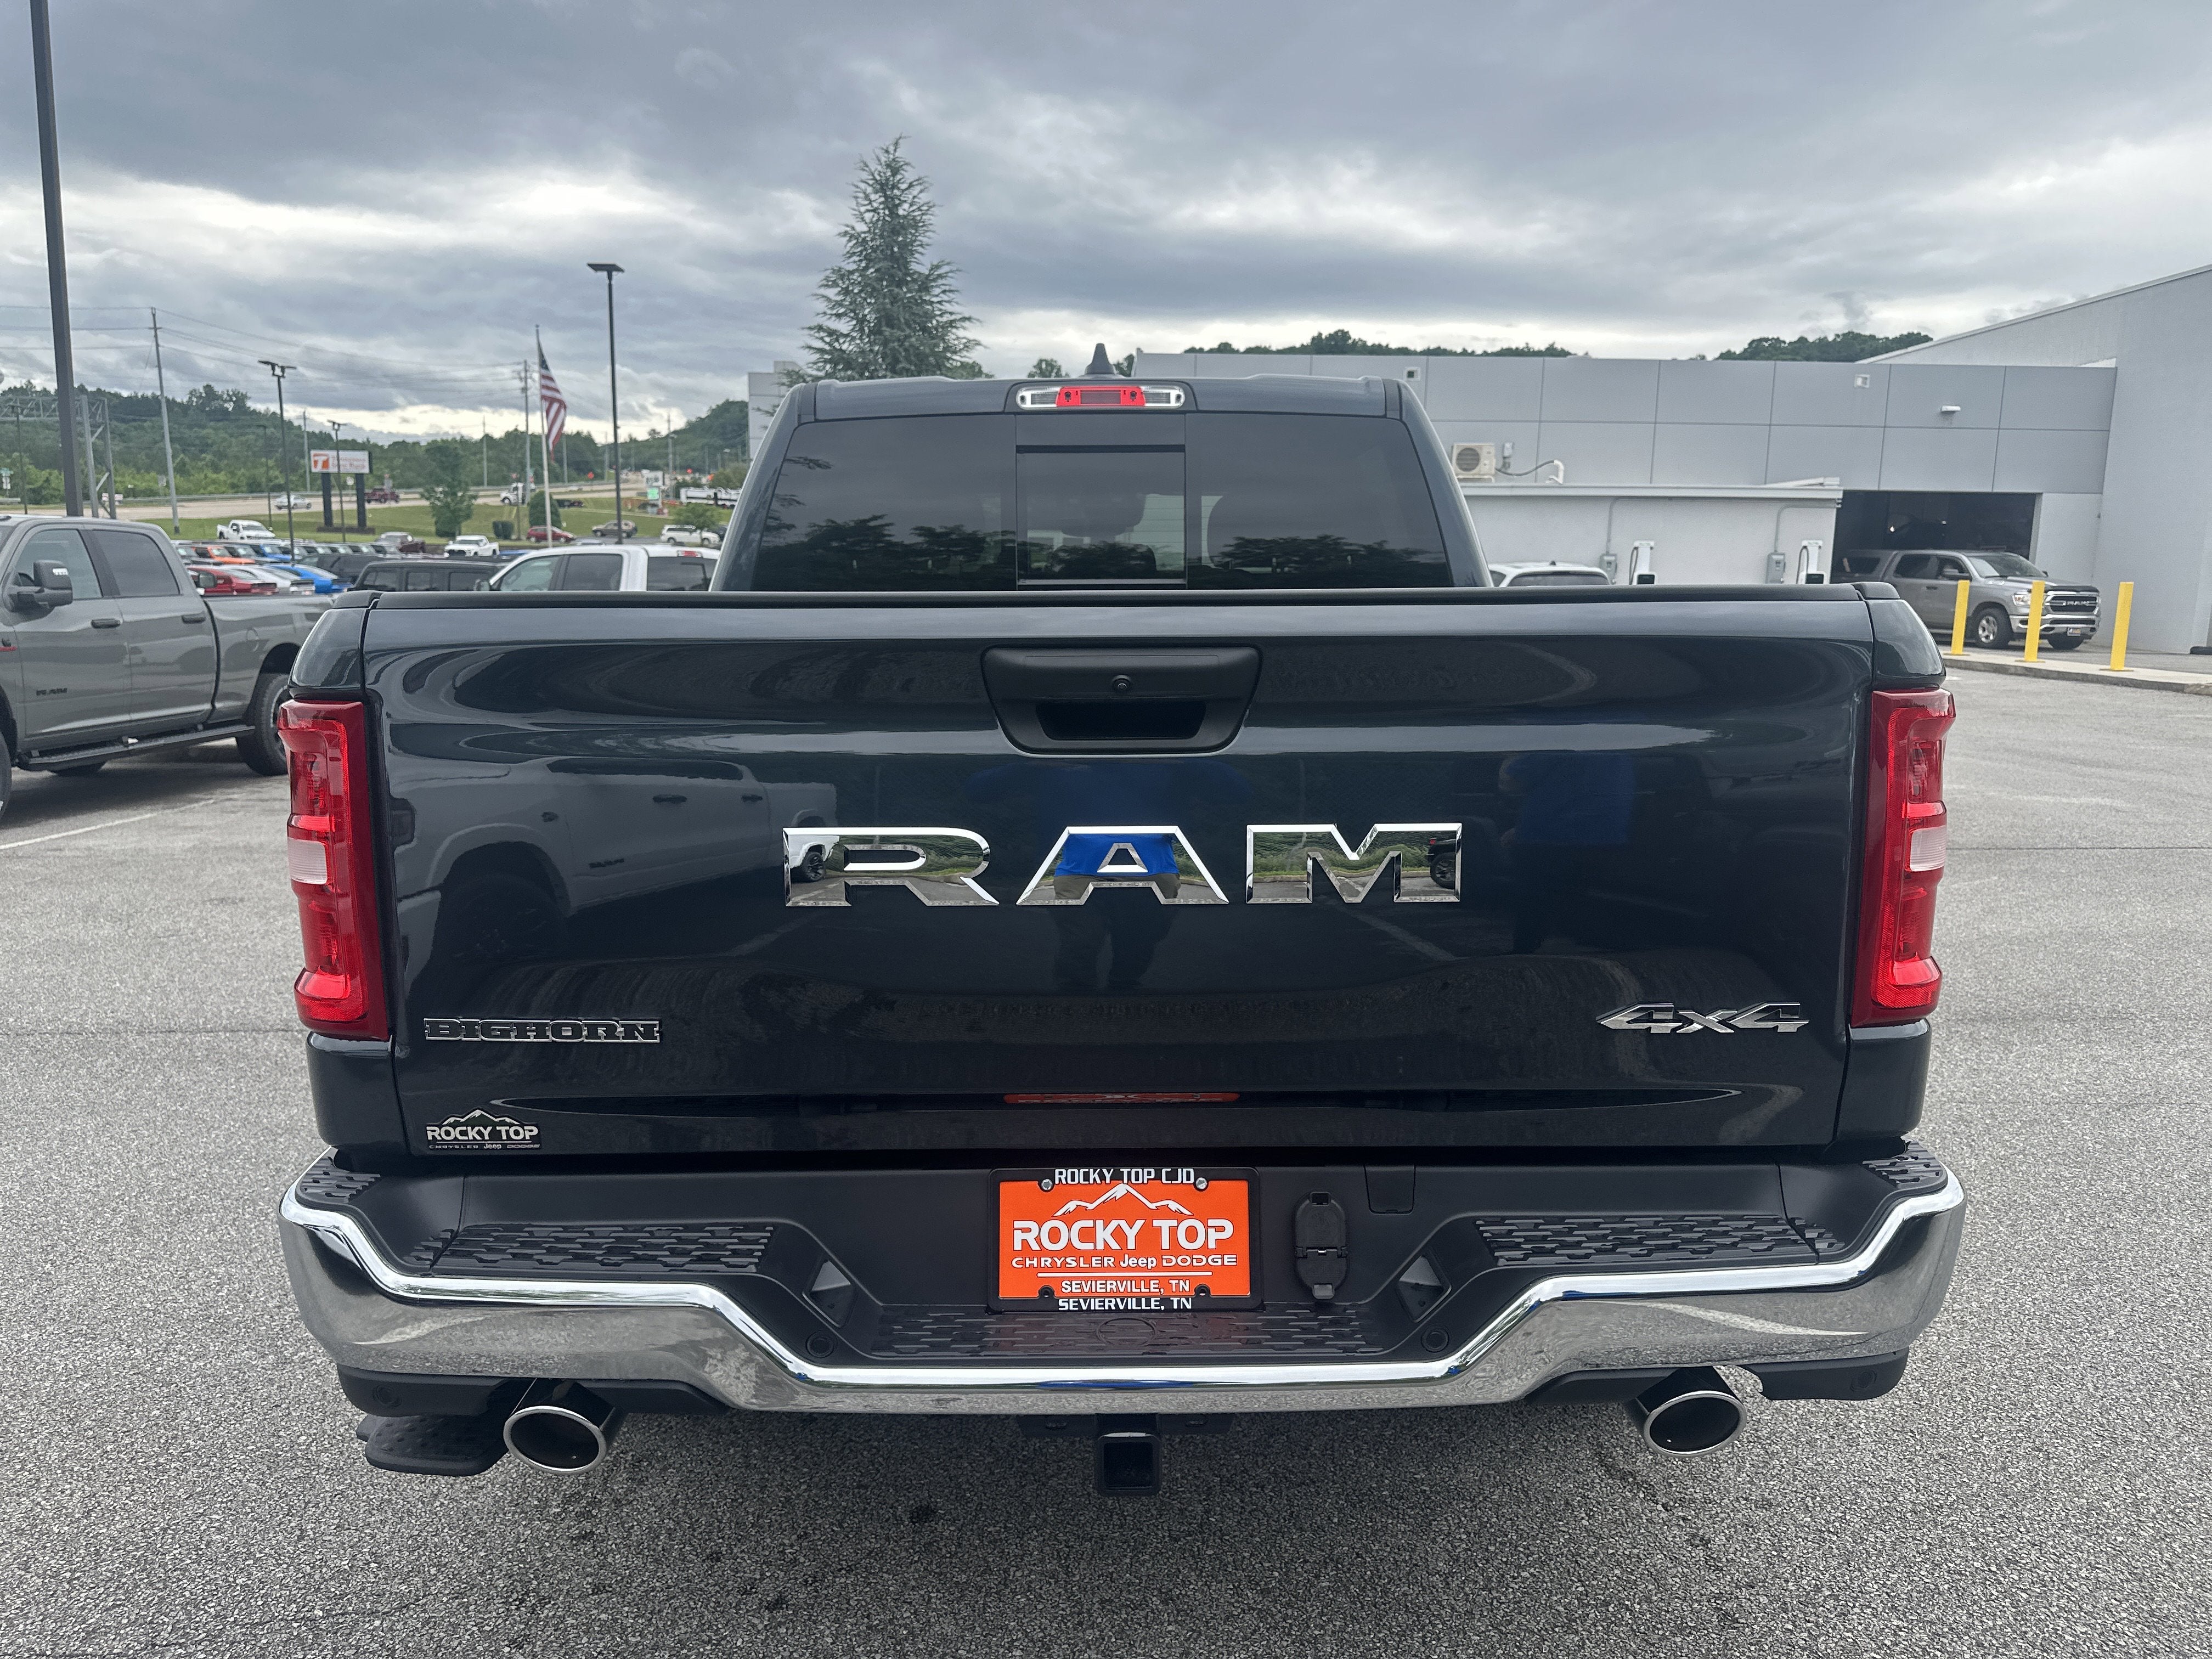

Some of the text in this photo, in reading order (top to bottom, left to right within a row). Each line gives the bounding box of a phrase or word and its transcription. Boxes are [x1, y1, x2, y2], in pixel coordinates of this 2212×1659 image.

[782, 823, 1462, 907] RAM
[424, 1018, 659, 1043] BIGHORN
[426, 1126, 539, 1141] ROCKY TOP
[1054, 1168, 1194, 1185] ROCKY TOP CJD
[1013, 1218, 1234, 1251] ROCKY TOP
[1011, 1254, 1237, 1270] CHRYSLER Jeep DODGE
[1061, 1279, 1189, 1295] SEVIERVILLE, TN
[1058, 1297, 1192, 1311] SEVIERVILLE, TN
